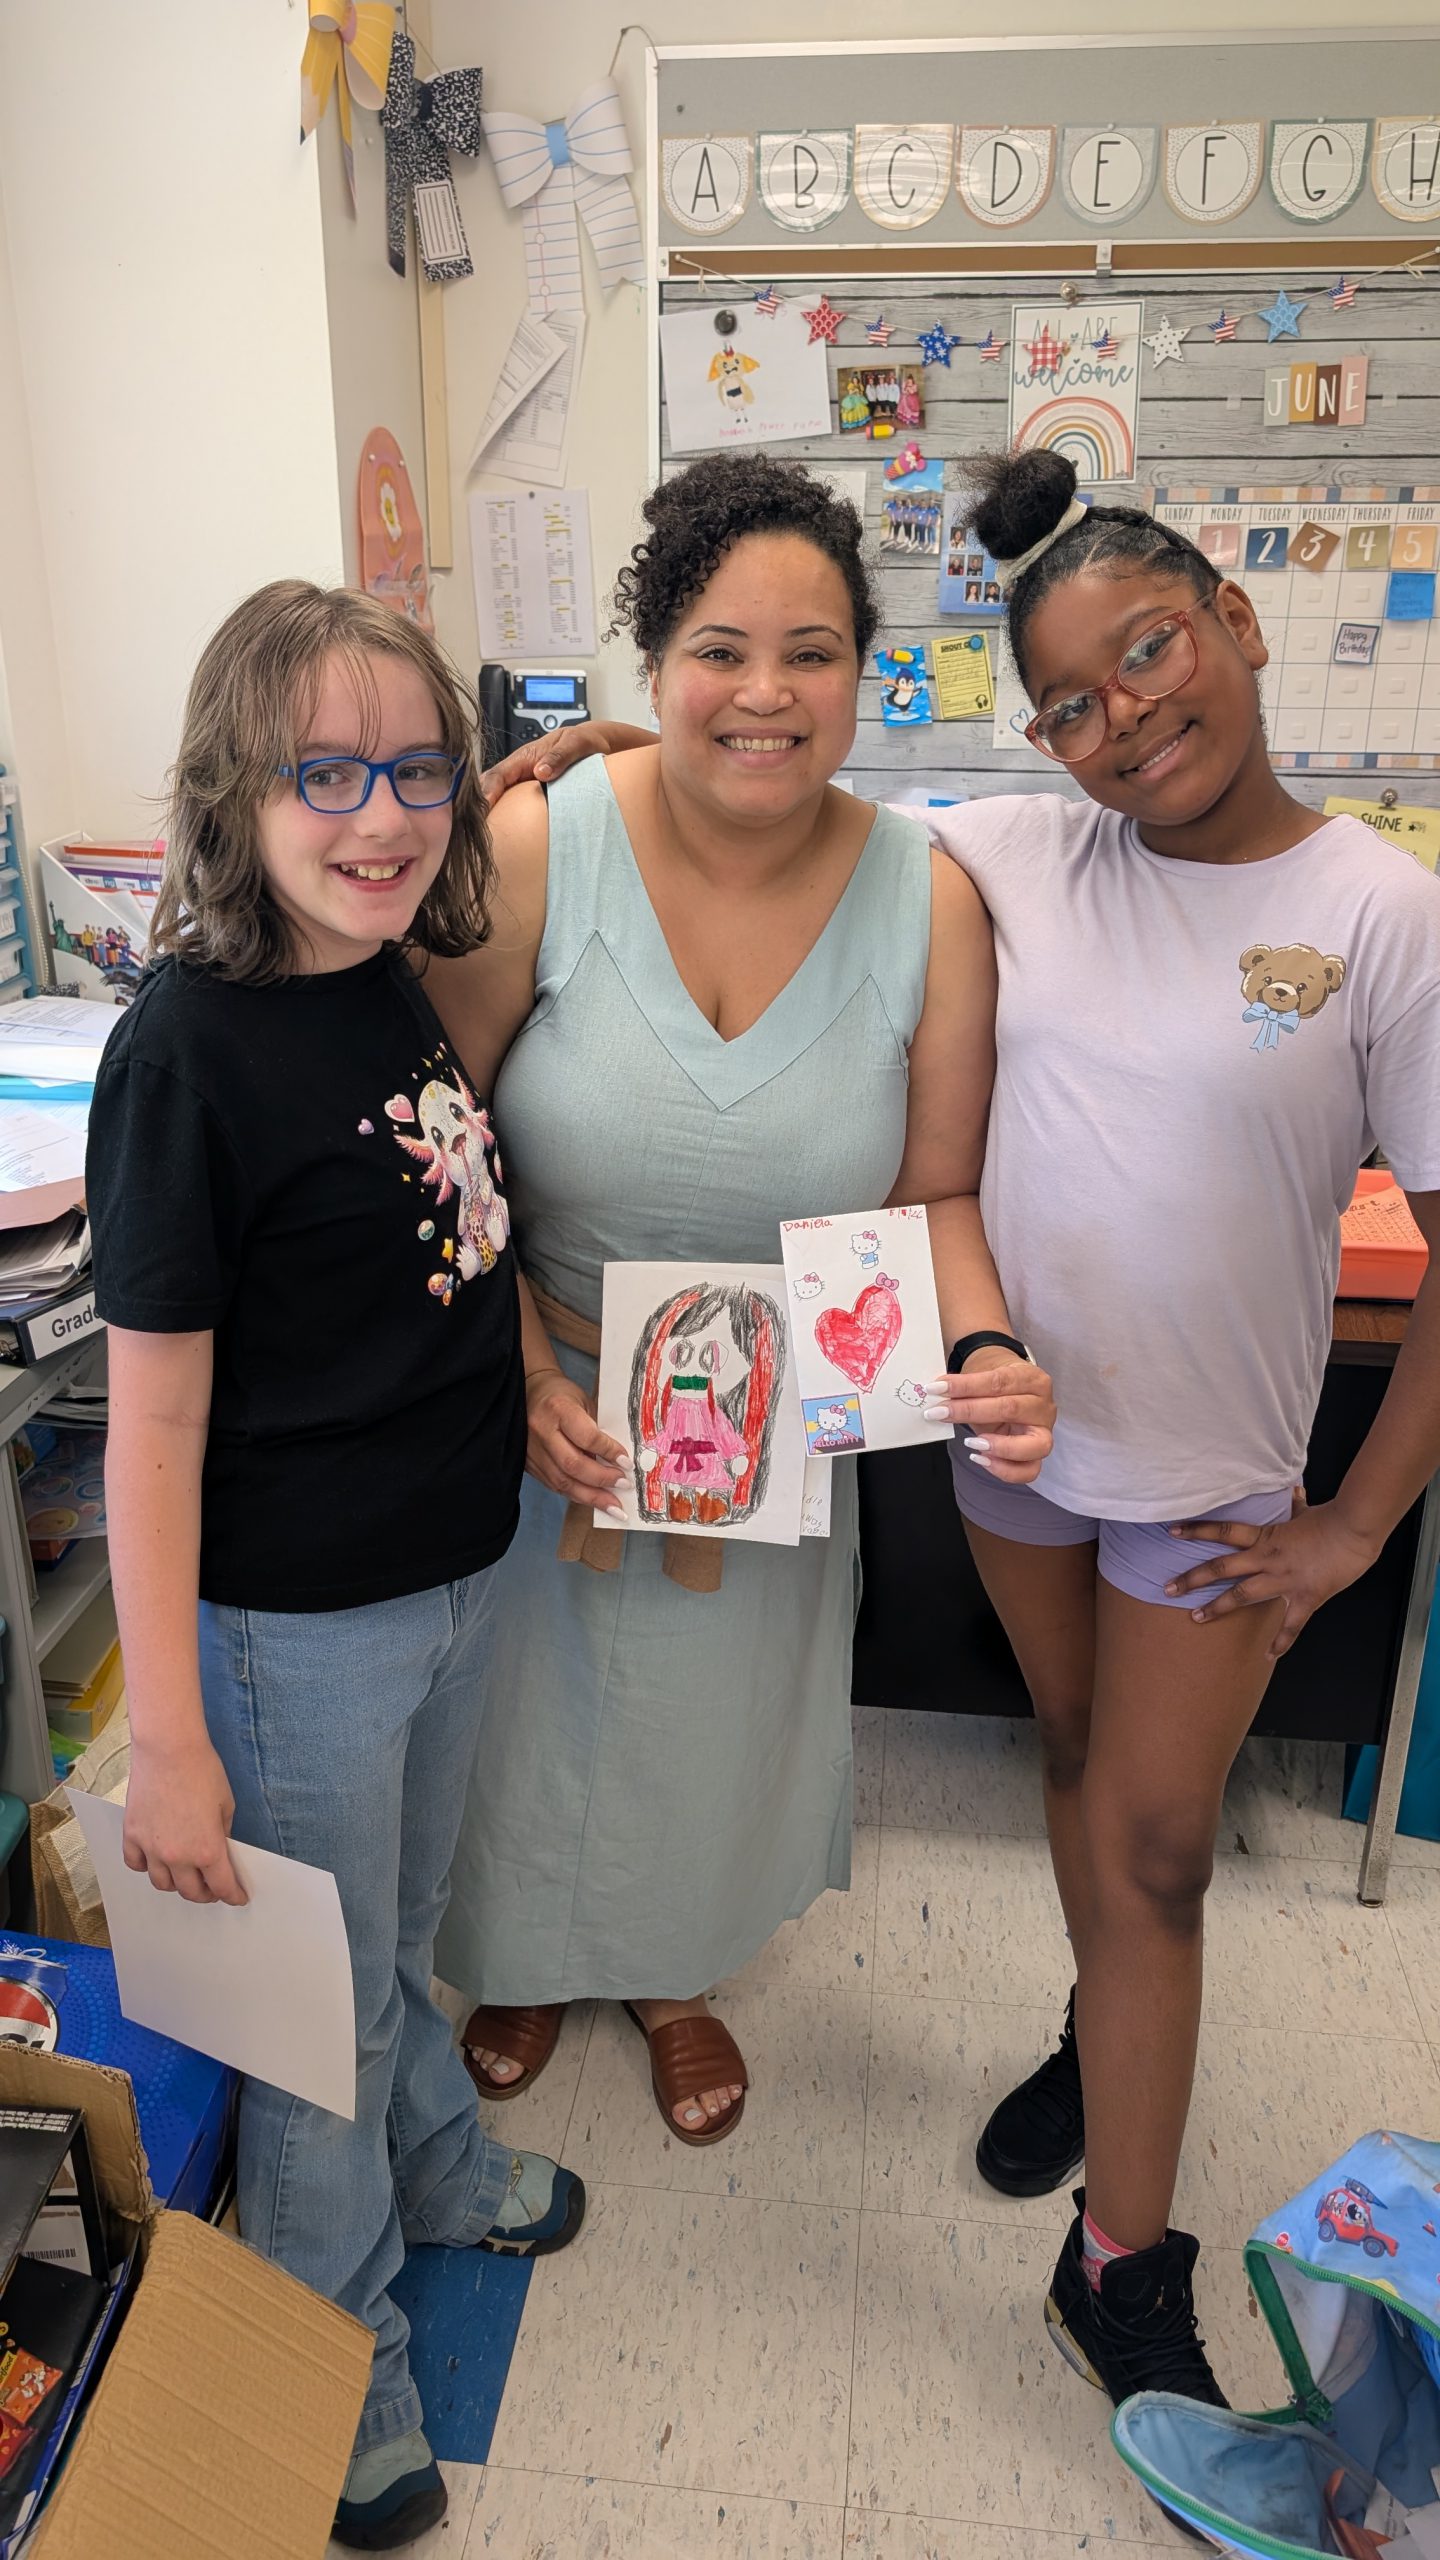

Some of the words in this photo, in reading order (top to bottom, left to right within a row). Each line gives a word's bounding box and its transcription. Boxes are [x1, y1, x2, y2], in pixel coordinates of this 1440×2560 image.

[691, 147, 719, 213] A
[793, 145, 819, 209] B
[888, 143, 916, 209] C
[990, 141, 1022, 209] D
[1093, 140, 1121, 207] E
[1201, 136, 1227, 205] F
[1302, 134, 1333, 202] G
[1409, 132, 1440, 201] H
[1015, 355, 1134, 396] welcome
[1267, 372, 1361, 417] JUNE
[1164, 507, 1194, 521] SUNDAY
[1210, 507, 1243, 521] MONDAY
[1259, 507, 1292, 521] TUESDAY
[1302, 507, 1348, 521] WEDNESDAY
[1353, 507, 1393, 521] THURSDAY
[1407, 507, 1435, 521] FRIDAY
[1211, 529, 1222, 560] 1
[1256, 531, 1276, 564] 2
[1300, 529, 1326, 562] 3
[1358, 530, 1377, 562] 4
[1402, 530, 1423, 563] 5
[1342, 629, 1368, 644] Happy
[940, 642, 963, 653] SHOUT
[1339, 642, 1371, 658] Birthday
[1361, 813, 1403, 832] SHINE
[783, 1218, 833, 1232] Daniela
[813, 1440, 836, 1448] HELLO
[837, 1437, 859, 1445] KITTY
